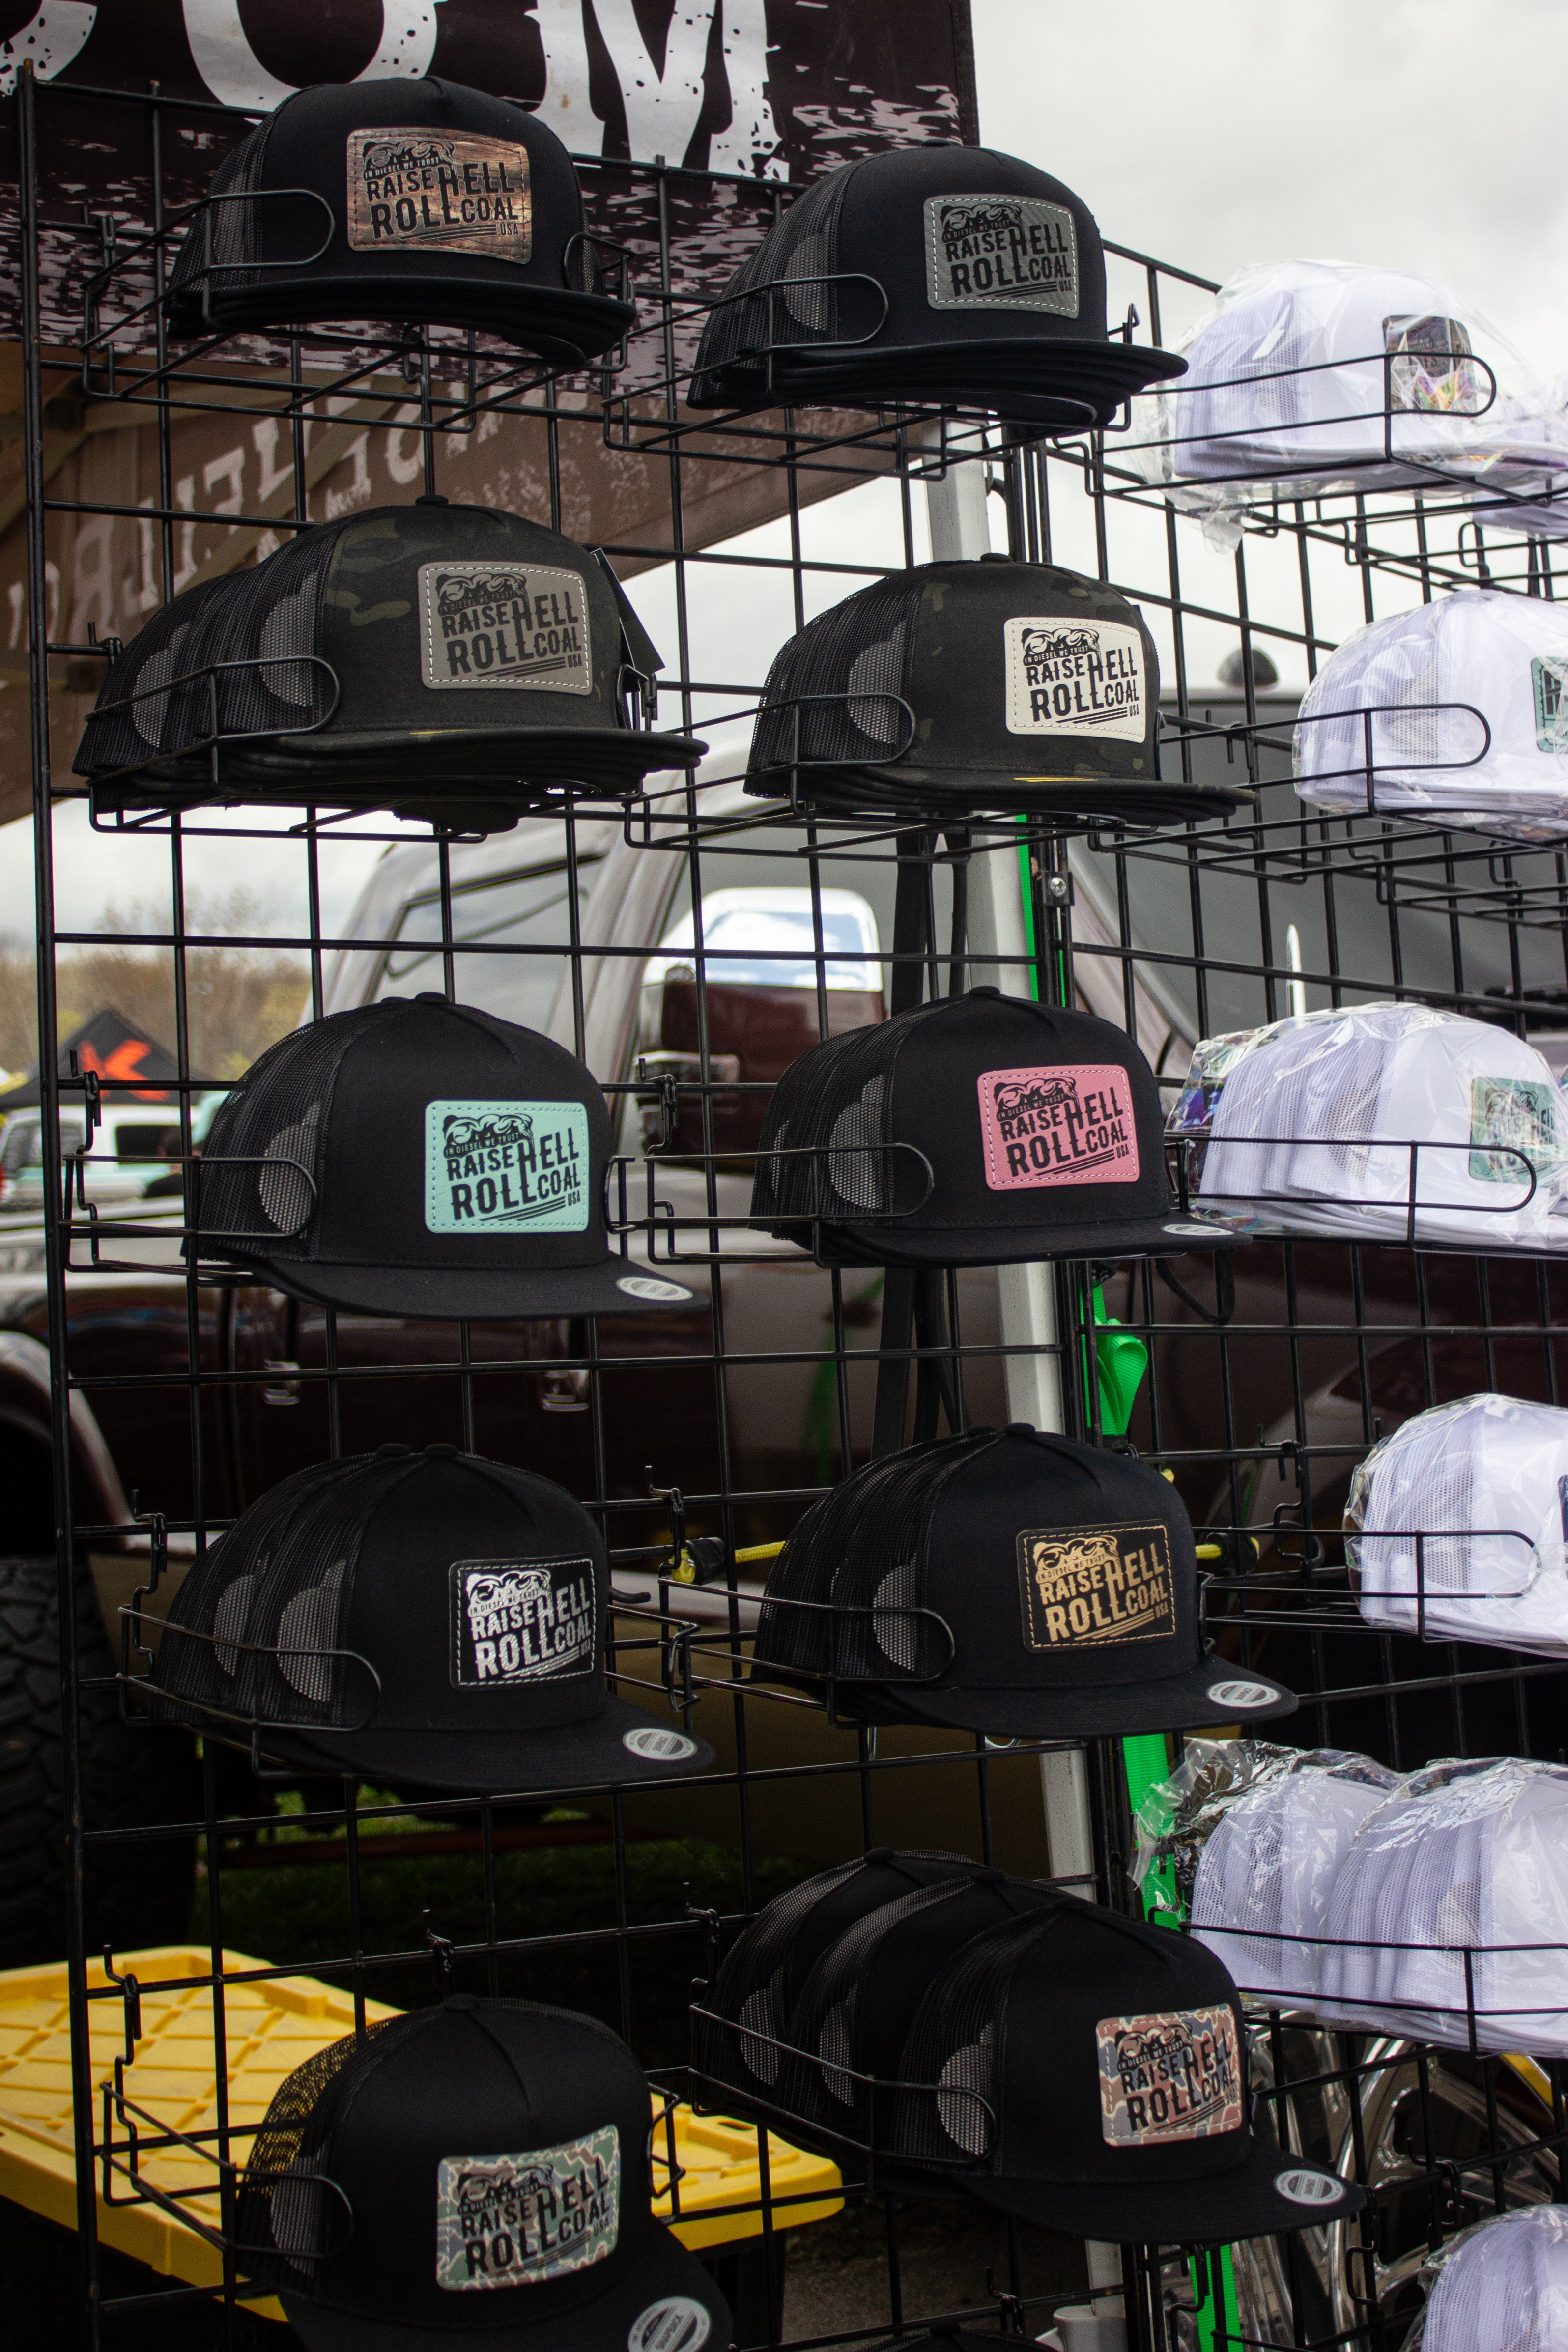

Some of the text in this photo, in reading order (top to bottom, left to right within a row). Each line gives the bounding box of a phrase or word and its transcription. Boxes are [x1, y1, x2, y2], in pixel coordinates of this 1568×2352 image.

[367, 163, 515, 202] RAISE HELL
[375, 165, 400, 175] DIESEL
[418, 157, 439, 167] TRUST
[371, 195, 518, 239] ROLL COAL
[500, 224, 518, 236] USA
[954, 228, 976, 238] DIESEL
[991, 220, 1009, 229] TRUST
[946, 223, 1068, 262] RAISE HELL
[951, 255, 1071, 297] ROLL COAL
[1059, 281, 1072, 292] USA
[441, 591, 578, 638] RAISE HELL
[451, 600, 476, 610] DIESEL
[492, 592, 513, 600] TRUST
[447, 627, 581, 676] ROLL COAL
[568, 654, 582, 667] USA
[1026, 647, 1137, 686] RAISE HELL
[1034, 652, 1056, 661] DIESEL
[1071, 645, 1088, 653] TRUST
[1030, 680, 1139, 722] ROLL COAL
[1129, 704, 1139, 716] USA
[1000, 1087, 1123, 1142] RAISE HELL
[1008, 1105, 1030, 1116] DIESEL
[1046, 1094, 1065, 1105] TRUST
[447, 1128, 579, 1181] RAISE HELL
[456, 1142, 482, 1153] DIESEL
[498, 1133, 519, 1143] TRUST
[1006, 1119, 1128, 1177] ROLL COAL
[1116, 1144, 1129, 1159] USA
[451, 1163, 581, 1221] ROLL COAL
[568, 1190, 581, 1206] USA
[1040, 1543, 1164, 1605] RAISE HELL
[1048, 1566, 1070, 1577] DIESEL
[1086, 1554, 1105, 1566] TRUST
[471, 1578, 590, 1640] RAISE HELL
[481, 1600, 505, 1611] DIESEL
[519, 1590, 539, 1600] TRUST
[1045, 1577, 1168, 1642] ROLL COAL
[1155, 1601, 1169, 1618] USA
[475, 1612, 591, 1679] ROLL COAL
[1121, 2028, 1231, 2094] RAISE HELL
[1126, 2066, 1234, 2131] ROLL COAL
[461, 2158, 607, 2238] RAISE HELL
[466, 2192, 610, 2276] ROLL COAL
